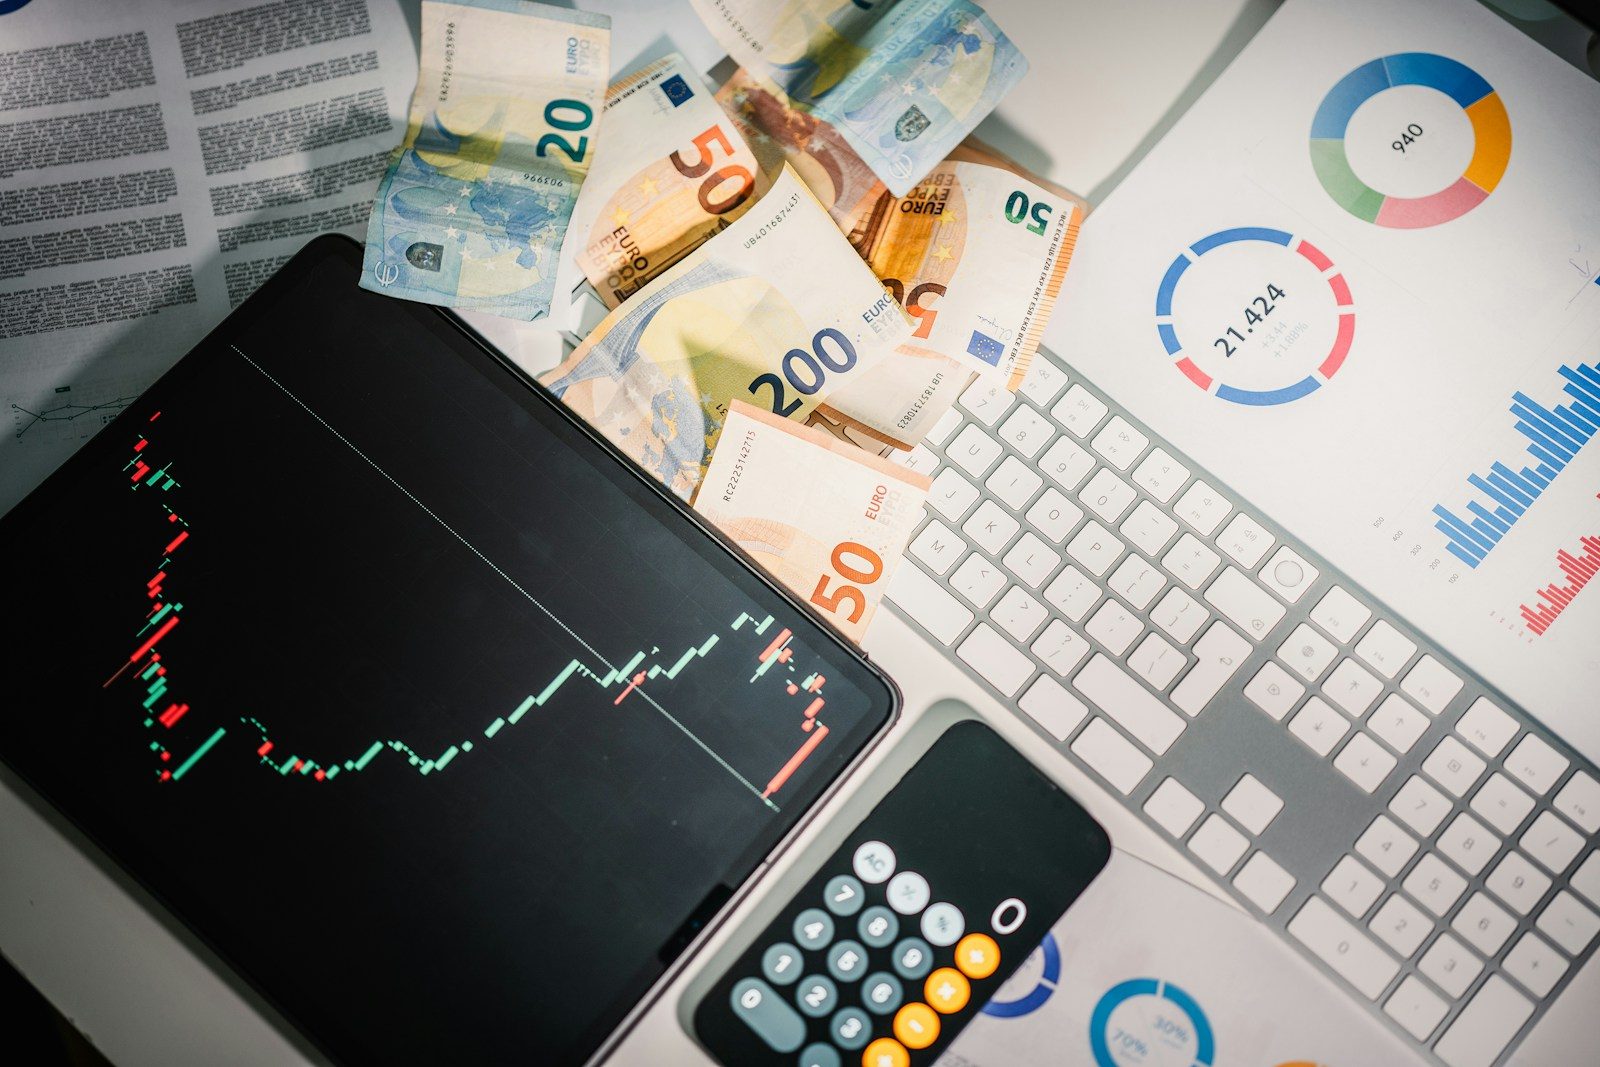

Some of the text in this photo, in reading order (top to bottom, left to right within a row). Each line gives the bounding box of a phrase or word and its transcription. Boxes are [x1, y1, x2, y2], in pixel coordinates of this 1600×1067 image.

[566, 37, 579, 74] EURO
[536, 99, 593, 163] 20
[1391, 123, 1425, 154] 940
[669, 124, 755, 215] 50
[523, 173, 564, 187] 903996
[900, 200, 945, 215] EURO
[1004, 190, 1053, 237] 50
[743, 193, 801, 250] UB4016874431
[612, 225, 649, 271] EURO
[1213, 283, 1286, 358] 21.424
[748, 327, 858, 418] 200
[897, 372, 944, 429] UB1857310823
[977, 399, 988, 408] 7
[1015, 431, 1027, 442] 8
[968, 444, 981, 456] U
[722, 430, 756, 502] RC2225142715
[905, 456, 918, 468] H
[1056, 462, 1067, 473] 9
[945, 490, 957, 499] J
[864, 484, 888, 521] EURO
[985, 521, 997, 533] K
[1373, 516, 1386, 529] 500
[1391, 530, 1404, 543] 400
[930, 539, 945, 554] M
[1090, 542, 1102, 551] P
[1410, 544, 1422, 557] 300
[1026, 554, 1034, 566] L
[1429, 558, 1441, 571] 200
[809, 541, 884, 625] 50
[1448, 573, 1460, 585] 100
[1414, 799, 1428, 811] 7
[1382, 840, 1392, 852] 4
[1462, 838, 1475, 850] 8
[864, 853, 886, 873] AC
[1428, 878, 1441, 892] 5
[1512, 876, 1524, 889] 9
[834, 884, 855, 903] 7
[990, 897, 1027, 935] 0
[804, 921, 824, 939] 4
[1394, 918, 1407, 932] 2
[1477, 918, 1490, 931] 6
[774, 954, 792, 973] 1
[1443, 958, 1456, 972] 3
[740, 988, 762, 1009] 0
[805, 985, 828, 1008] 2
[840, 1017, 862, 1039] 3
